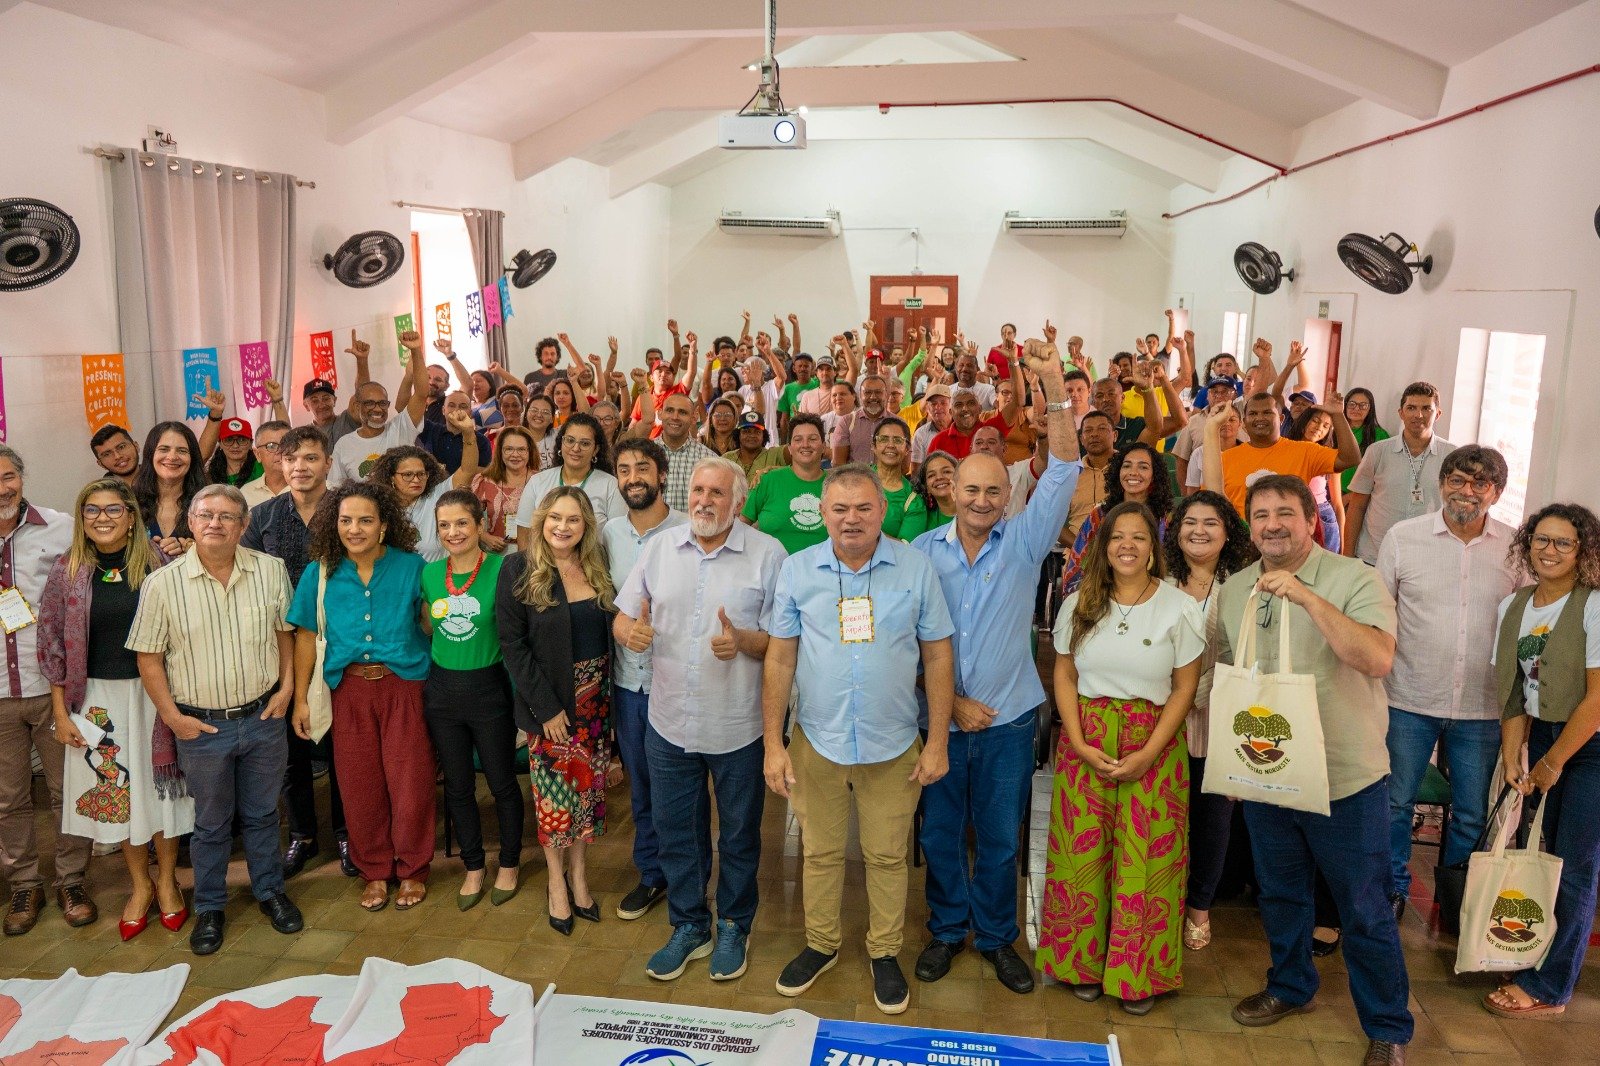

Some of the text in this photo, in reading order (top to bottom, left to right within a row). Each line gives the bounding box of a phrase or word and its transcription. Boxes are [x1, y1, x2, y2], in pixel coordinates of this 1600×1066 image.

[314, 336, 329, 348] VIVA
[85, 370, 122, 386] PRESENTE
[102, 382, 107, 395] É
[88, 396, 122, 413] COLETIVO
[1234, 748, 1291, 775] MAIS GESTÃO NORDESTE
[1486, 932, 1544, 953] MAIS GESTÃO NORDESTE
[594, 1022, 636, 1034] ITAPIPOCA
[636, 1026, 649, 1035] DE
[648, 1027, 708, 1041] COMUNIDADES
[582, 1028, 760, 1054] FEDERAÇÃO DAS ASSOCIAÇÕES, MORADORES,
[716, 1035, 753, 1046] BAIRROS
[930, 1040, 997, 1053] DESDE 1995
[927, 1052, 1001, 1066] TORRADO
